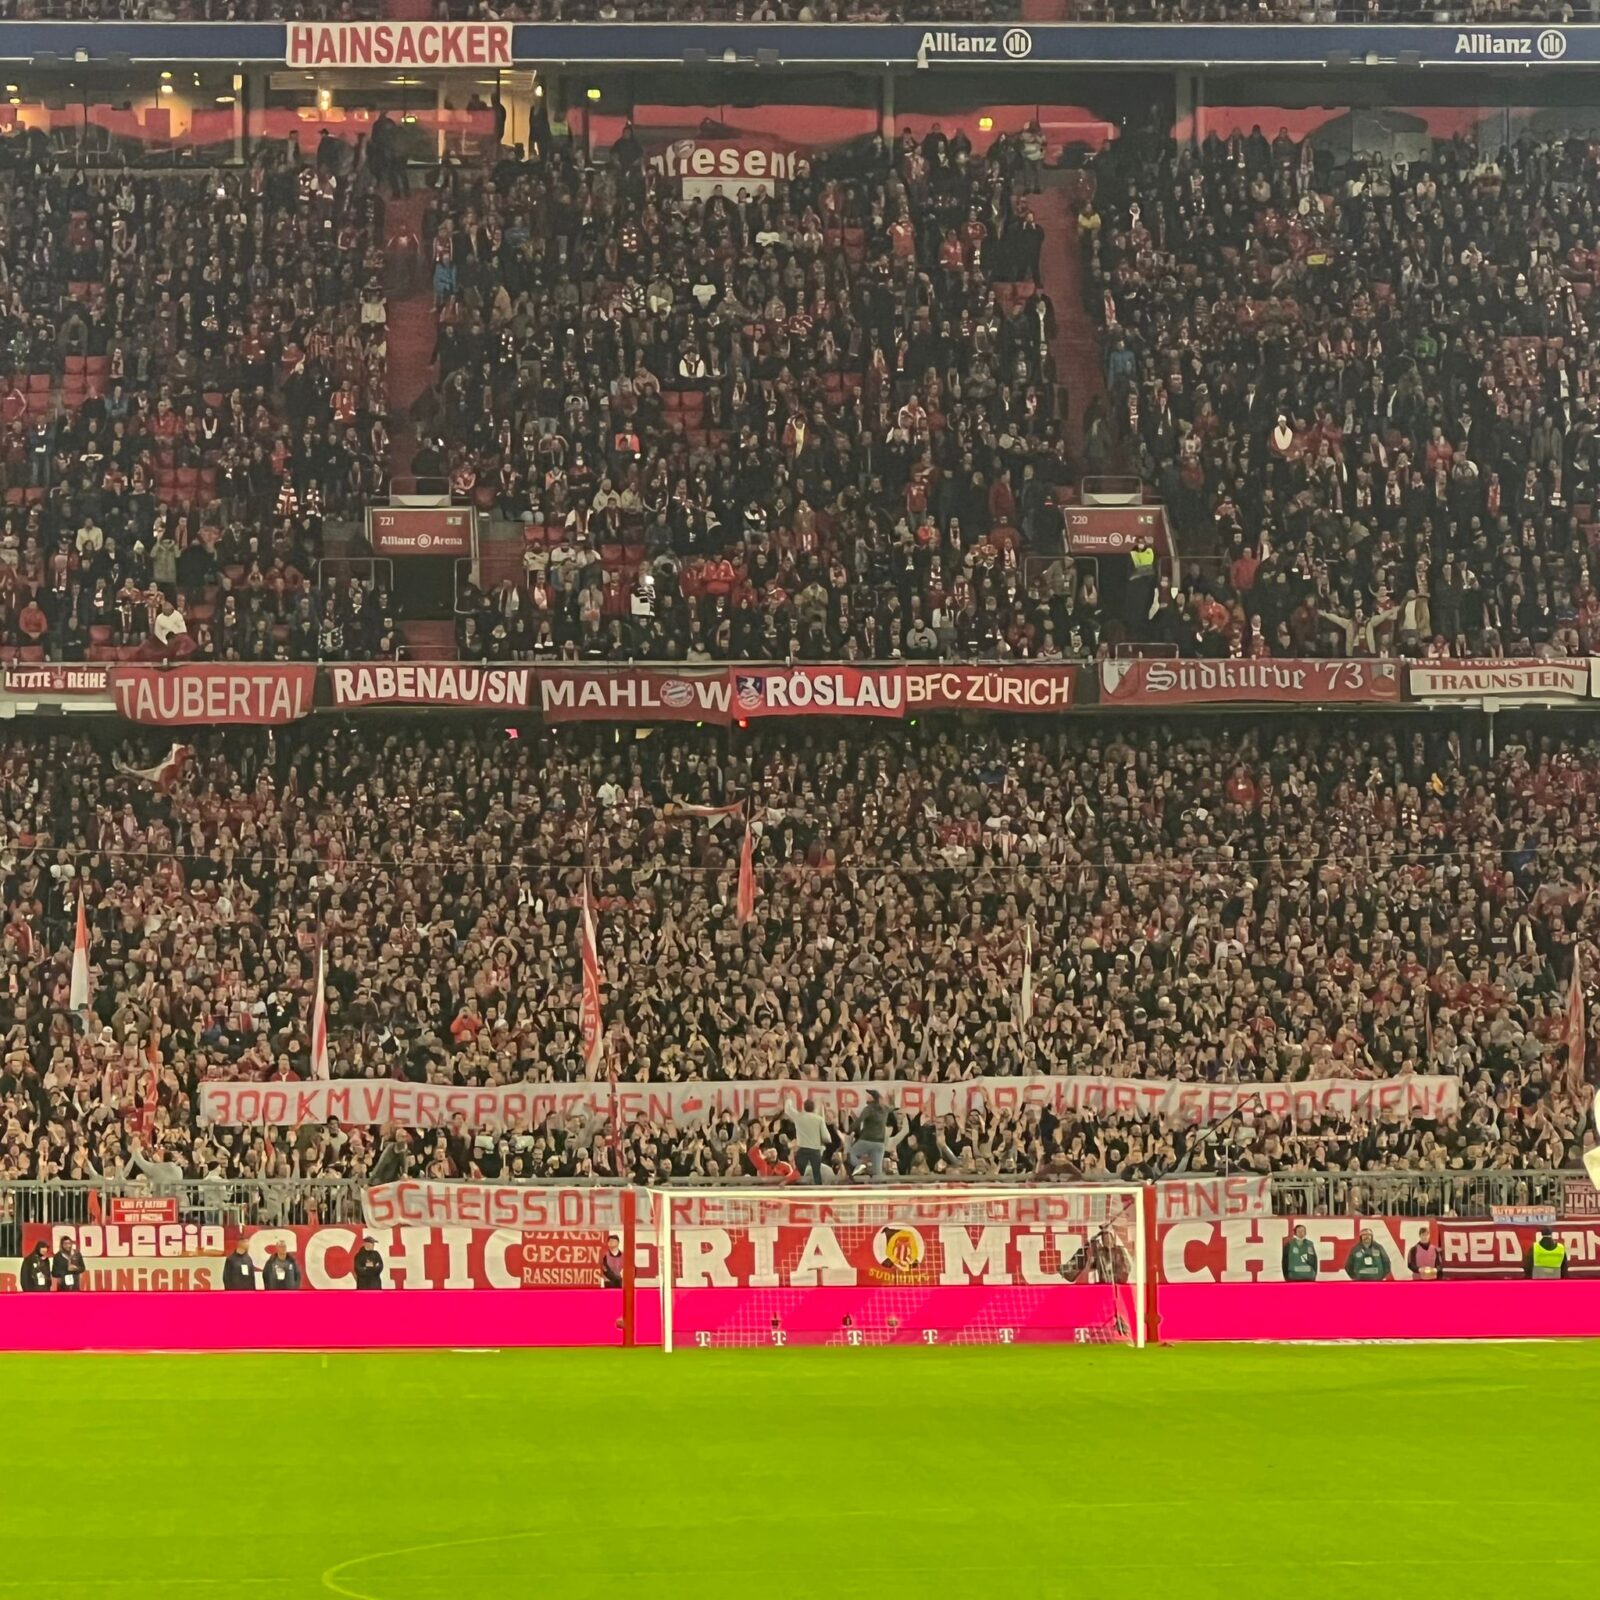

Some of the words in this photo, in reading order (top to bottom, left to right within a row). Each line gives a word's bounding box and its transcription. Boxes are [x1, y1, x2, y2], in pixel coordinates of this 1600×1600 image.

[291, 26, 511, 64] HAINSACKER
[920, 32, 997, 52] Allianz
[1455, 34, 1532, 53] Allianz
[381, 536, 416, 545] Allianz
[433, 536, 463, 545] Arena
[5, 672, 51, 688] LETZTE
[68, 672, 107, 689] REIHE
[334, 667, 529, 704] RABENAU/SN
[766, 671, 902, 709] RÖSLAU
[906, 674, 961, 702] BFC
[966, 673, 1069, 705] ZÜRICH
[1426, 672, 1575, 690] TRAUNSTEIN
[116, 677, 309, 719] TAUBERTAL
[208, 1089, 287, 1124] 300
[367, 1181, 547, 1225] SCHEISS
[523, 1244, 602, 1264] GEGEN
[523, 1266, 602, 1285] RASSISMUS
